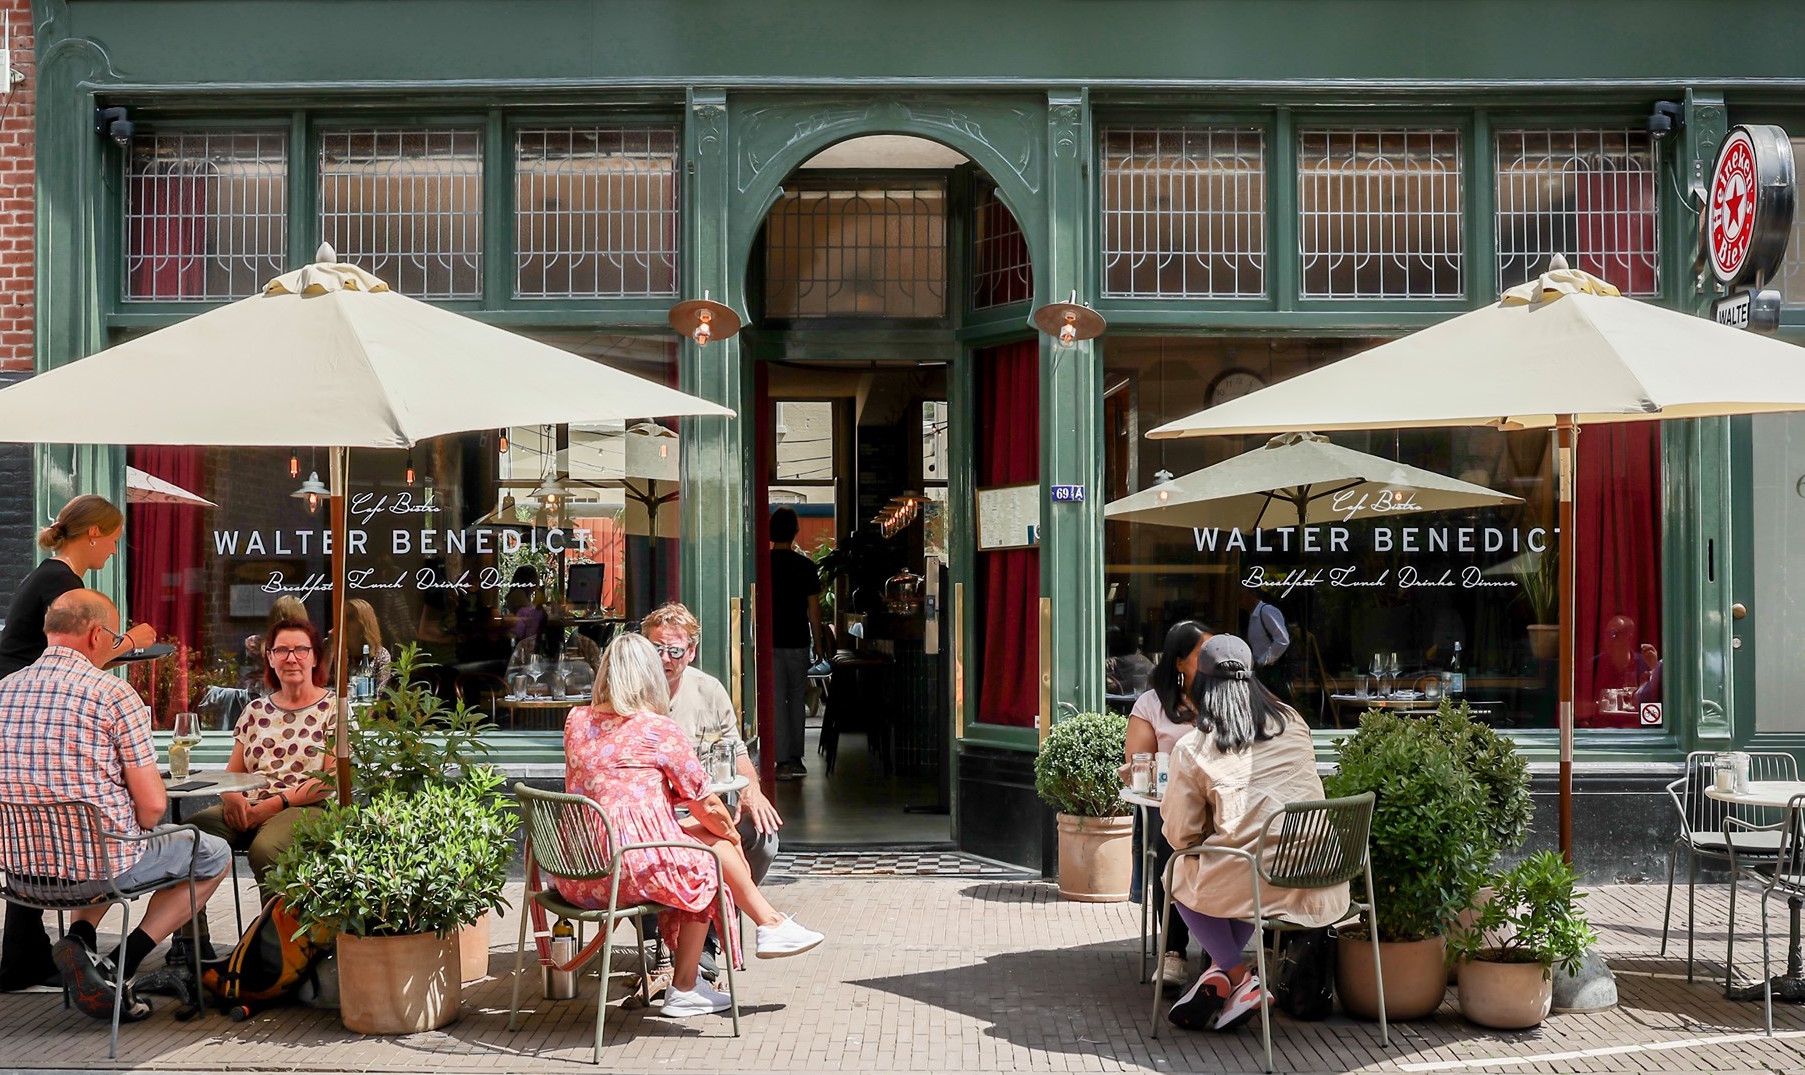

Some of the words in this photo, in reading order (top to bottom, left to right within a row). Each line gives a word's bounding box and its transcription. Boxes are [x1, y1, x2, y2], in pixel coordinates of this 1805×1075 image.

[1718, 236, 1745, 267] Bier
[1719, 303, 1750, 325] WALTE
[389, 492, 441, 514] Bistro
[1056, 488, 1069, 499] 69
[1371, 490, 1423, 512] Bistro
[213, 530, 368, 555] WALTER
[392, 529, 591, 554] BENEDICT
[1193, 527, 1350, 552] WALTER
[1374, 527, 1561, 553] BENEDIC
[260, 570, 334, 604] Breakfast
[347, 567, 408, 590] Lunch
[415, 567, 473, 590] Drinks
[480, 566, 537, 590] Dinner
[1241, 565, 1325, 599] Breakfast
[1329, 565, 1390, 588] Lunch
[1397, 565, 1456, 589] Drinks
[1461, 565, 1518, 589] Dinner
